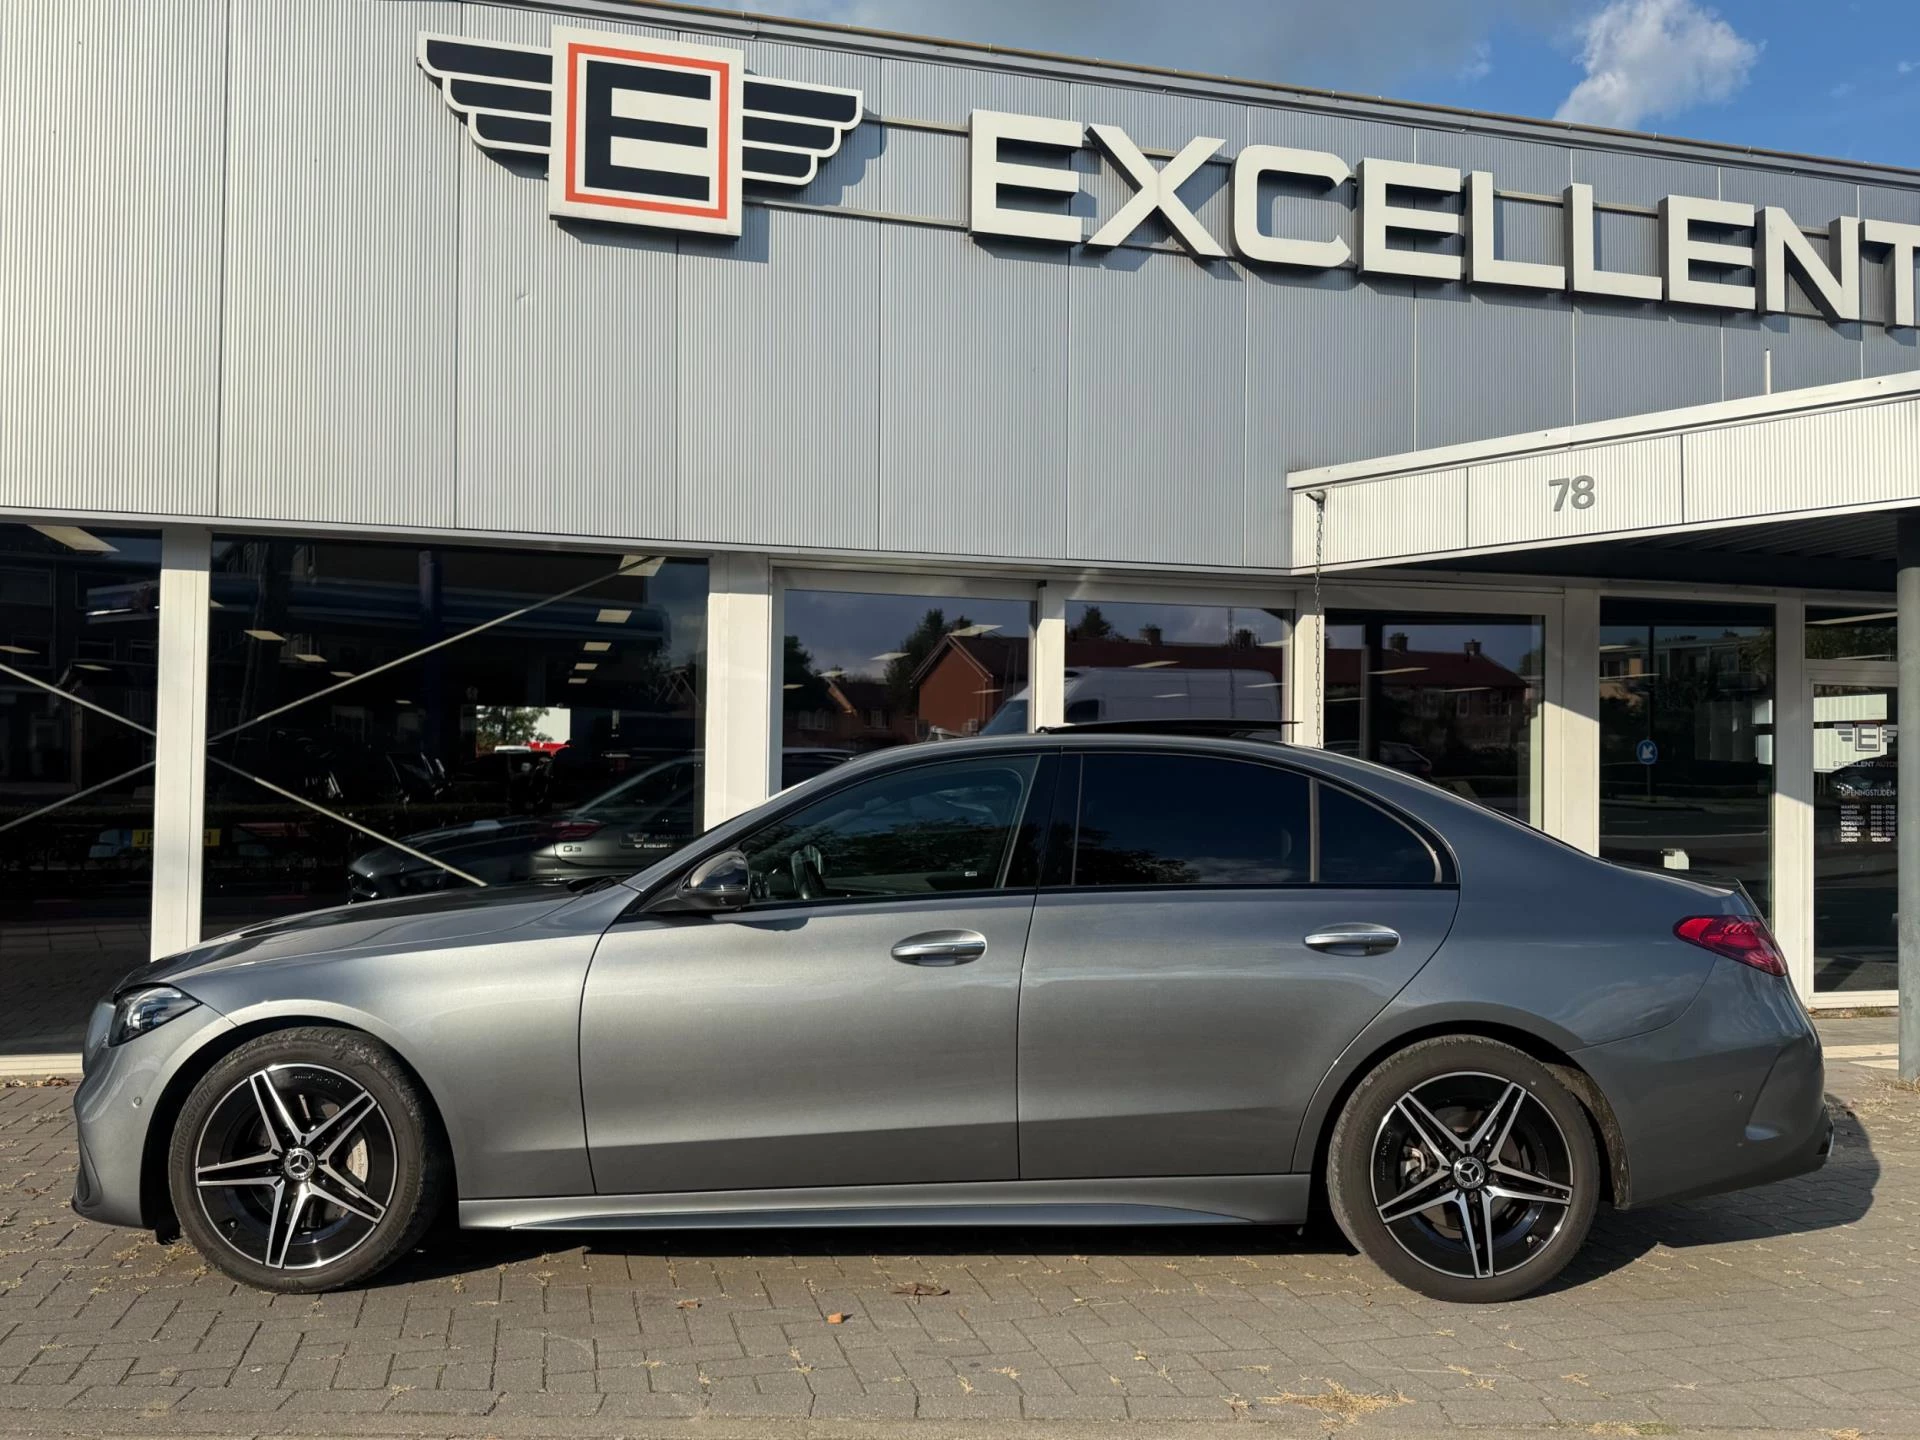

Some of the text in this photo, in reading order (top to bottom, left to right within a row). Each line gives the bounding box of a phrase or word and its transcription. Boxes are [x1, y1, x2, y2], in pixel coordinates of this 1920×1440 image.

[584, 59, 712, 202] E
[969, 108, 1920, 328] EXCELLENT
[1548, 475, 1595, 512] 78
